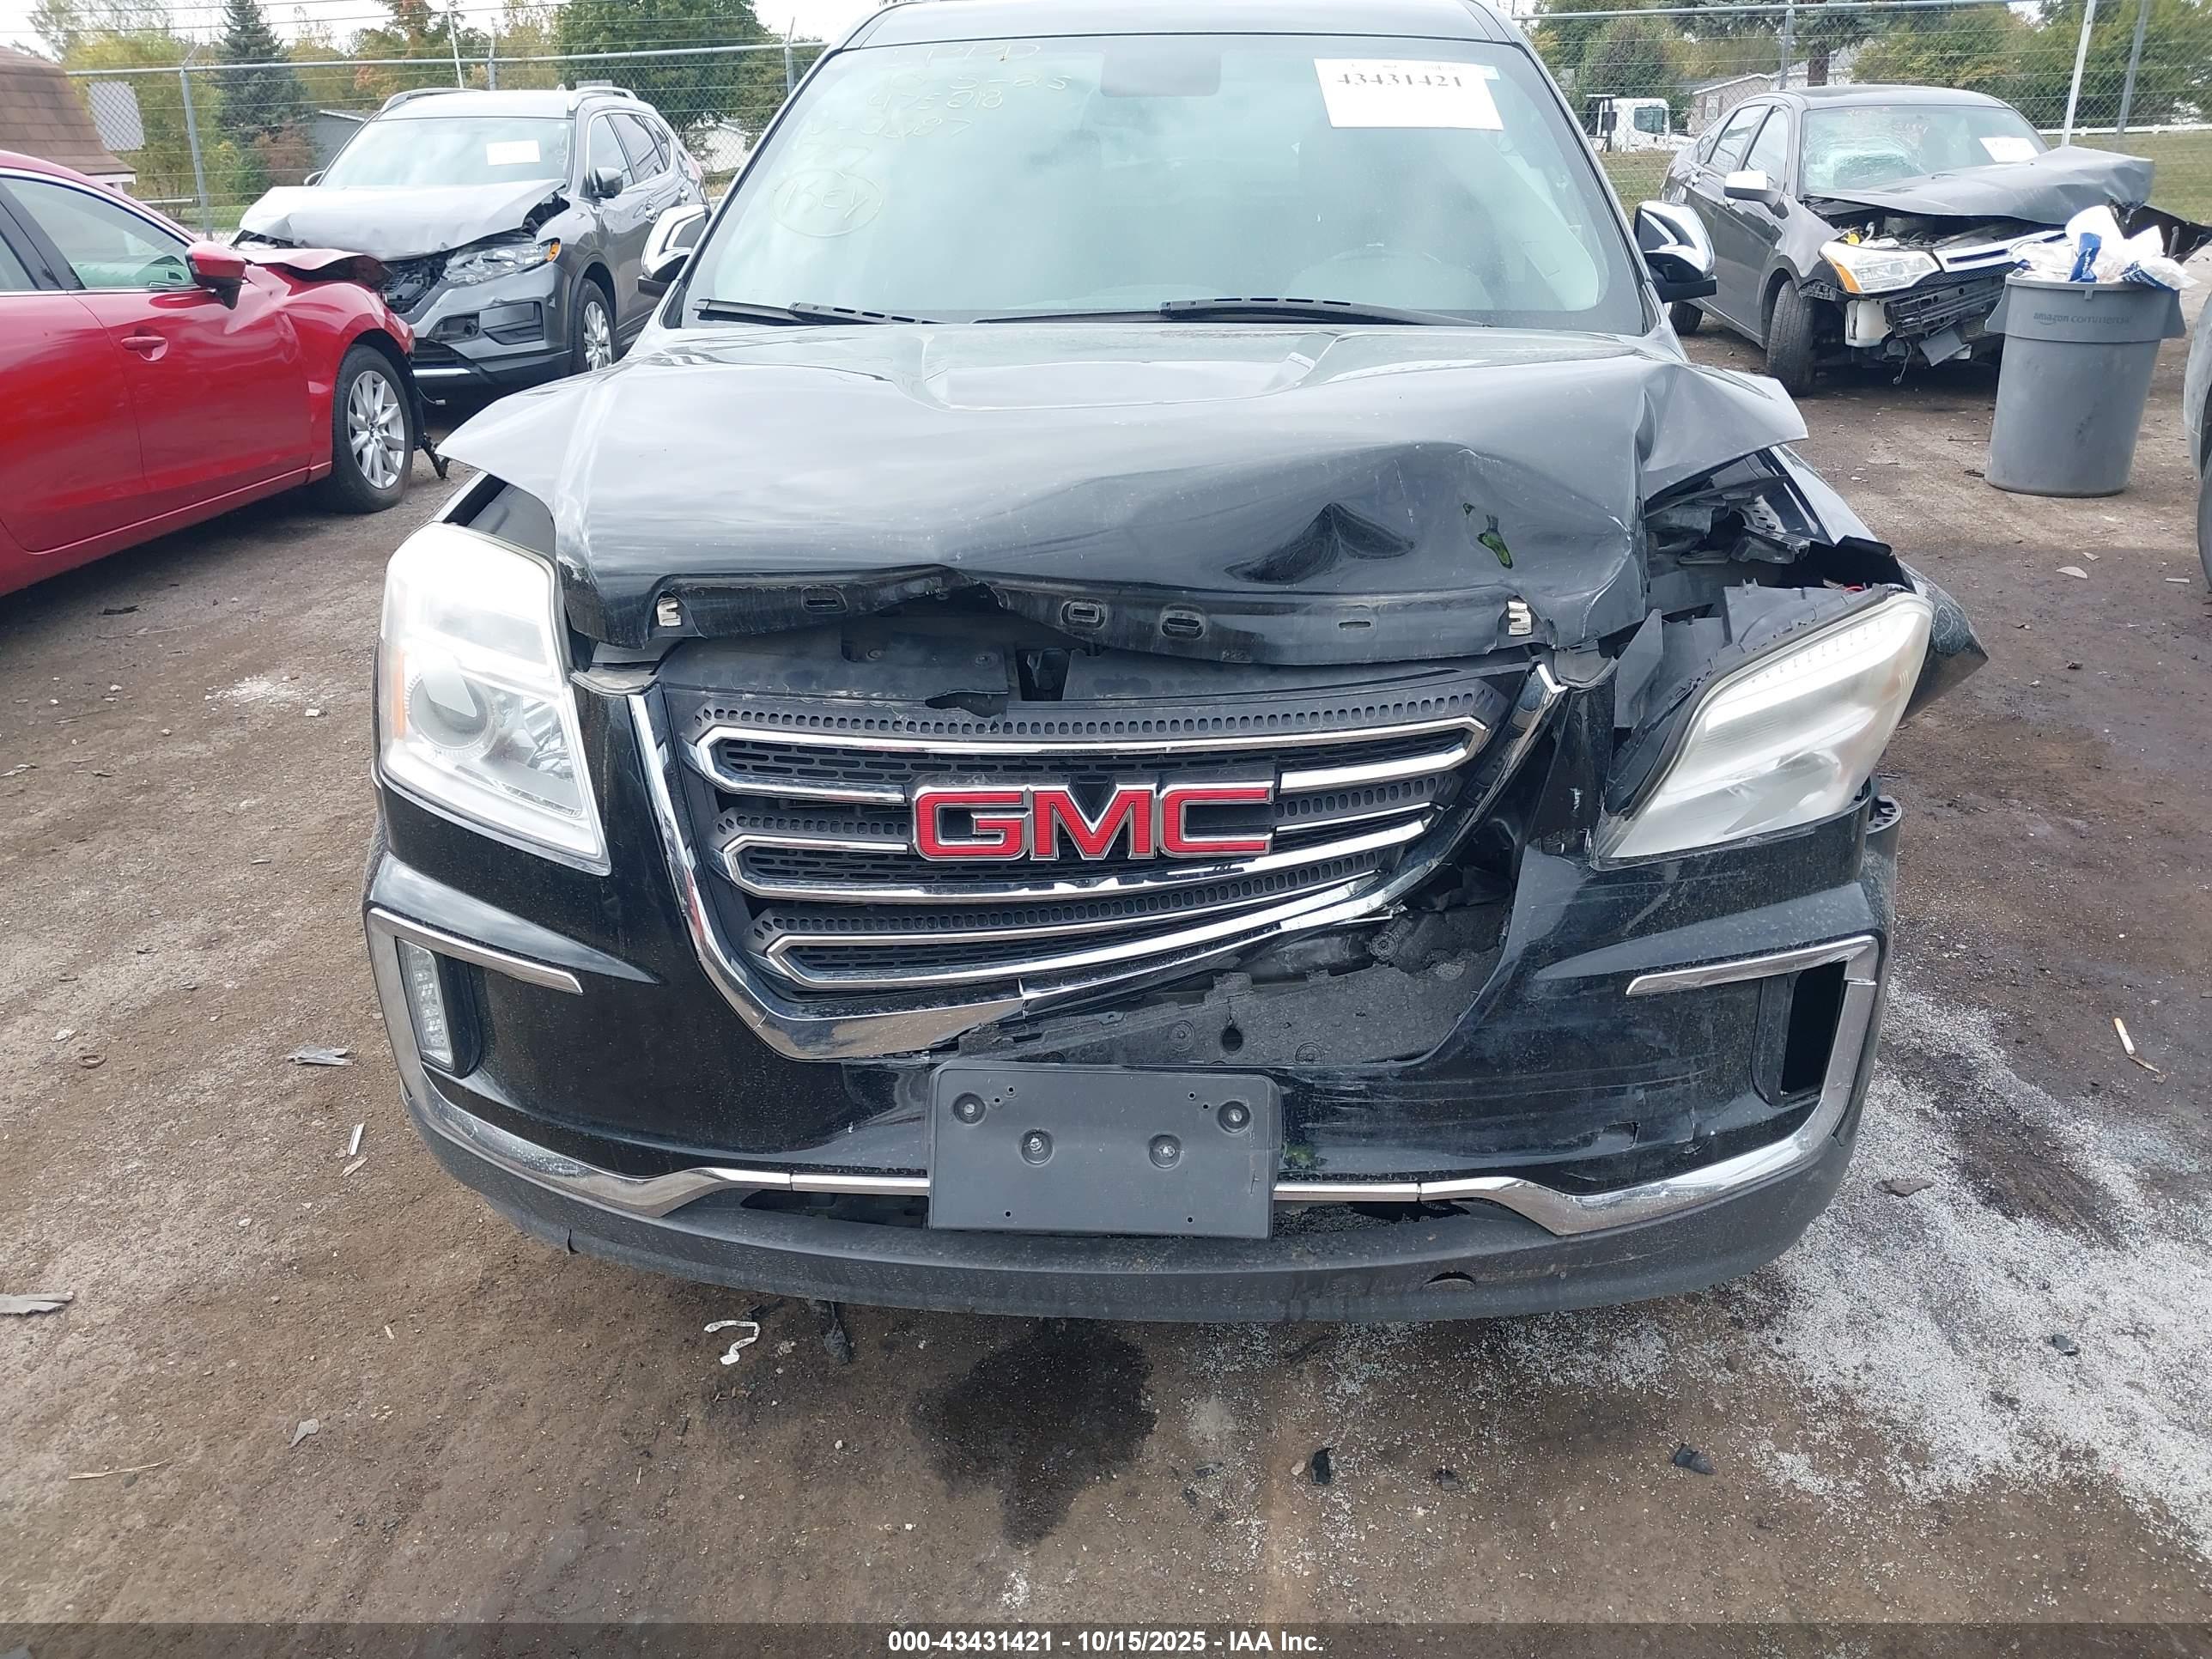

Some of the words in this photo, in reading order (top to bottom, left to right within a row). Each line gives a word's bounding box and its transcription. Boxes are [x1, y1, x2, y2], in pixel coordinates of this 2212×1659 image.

[1337, 74, 1462, 87] 43431421
[2033, 312, 2069, 325] amazon
[913, 781, 1274, 860] GMC
